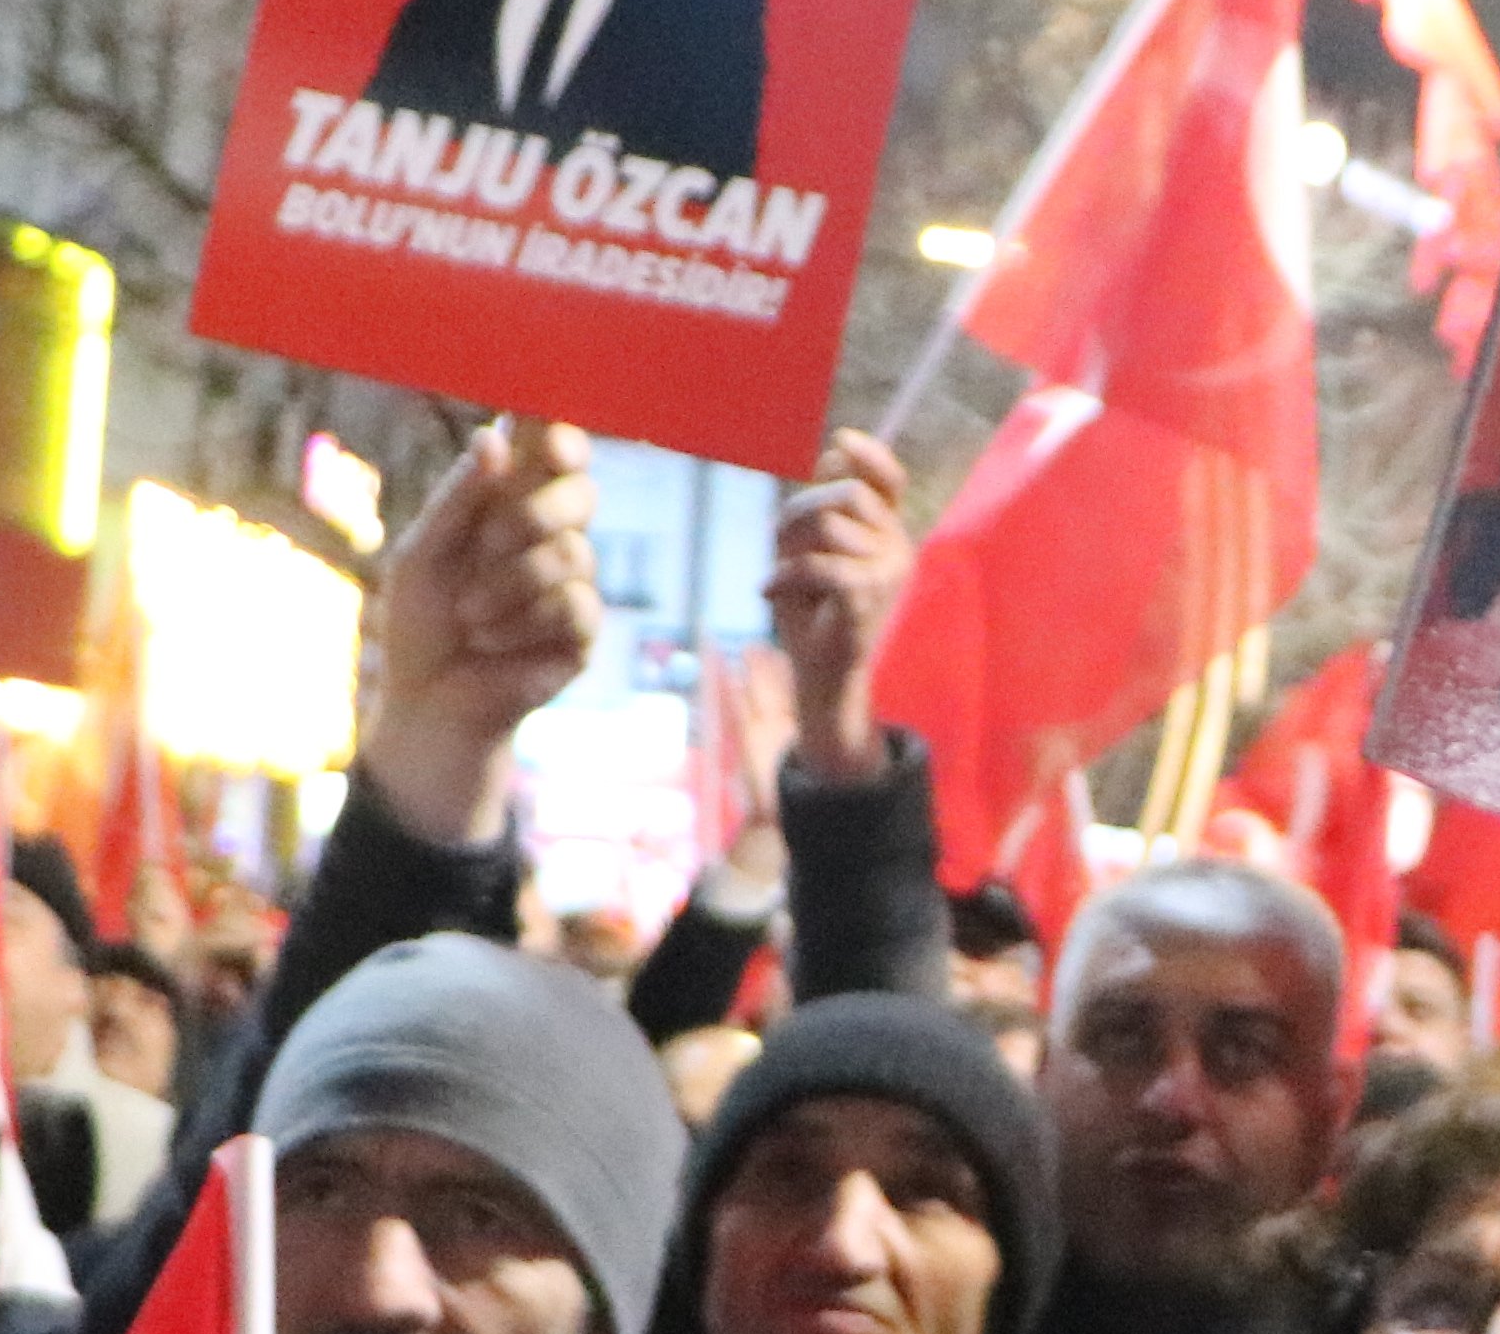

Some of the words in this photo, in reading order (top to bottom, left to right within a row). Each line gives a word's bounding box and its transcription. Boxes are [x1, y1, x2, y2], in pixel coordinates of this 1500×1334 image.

[275, 181, 519, 269] BOLU'NUN
[283, 87, 549, 209] TANJU
[552, 128, 829, 269] ÖZCAN
